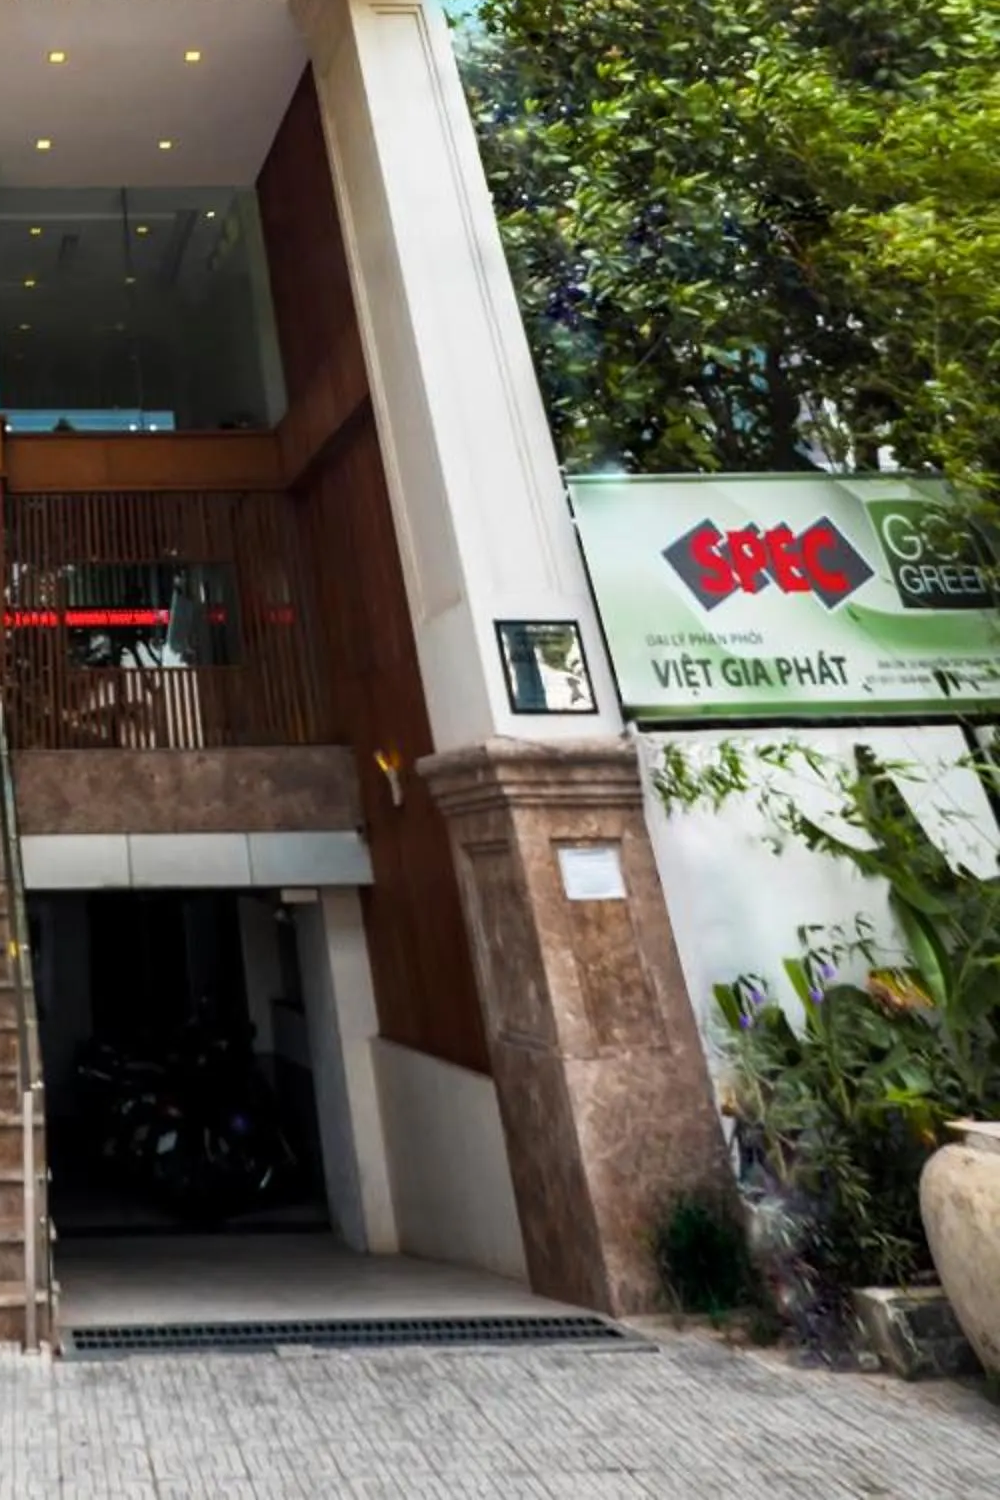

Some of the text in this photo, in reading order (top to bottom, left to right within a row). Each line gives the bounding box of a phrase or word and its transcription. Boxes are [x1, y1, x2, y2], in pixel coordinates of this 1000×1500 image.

[690, 527, 850, 594] SPEC
[651, 650, 848, 695] VIỆT GIA PHÁT
